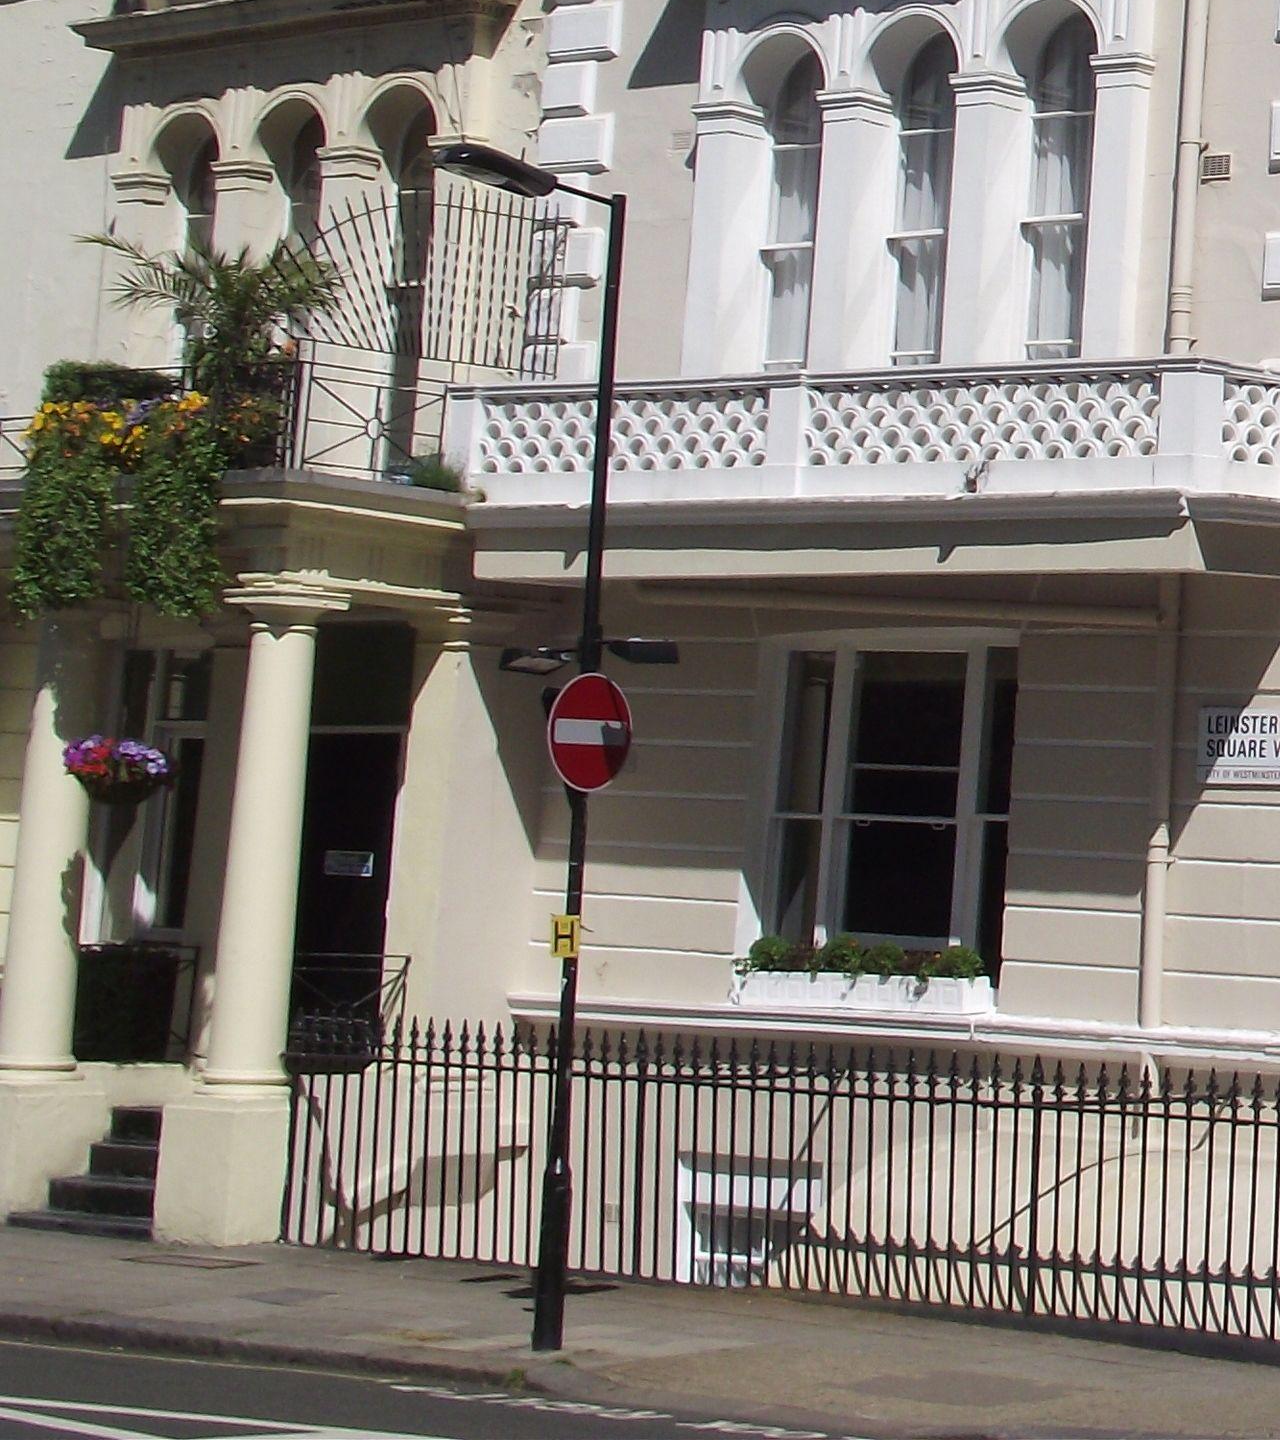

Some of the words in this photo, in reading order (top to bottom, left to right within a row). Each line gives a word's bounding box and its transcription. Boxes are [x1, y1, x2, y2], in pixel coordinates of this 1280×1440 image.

[1207, 715, 1279, 735] LEINSTER
[1206, 739, 1267, 758] SQUARE
[554, 920, 574, 953] H
